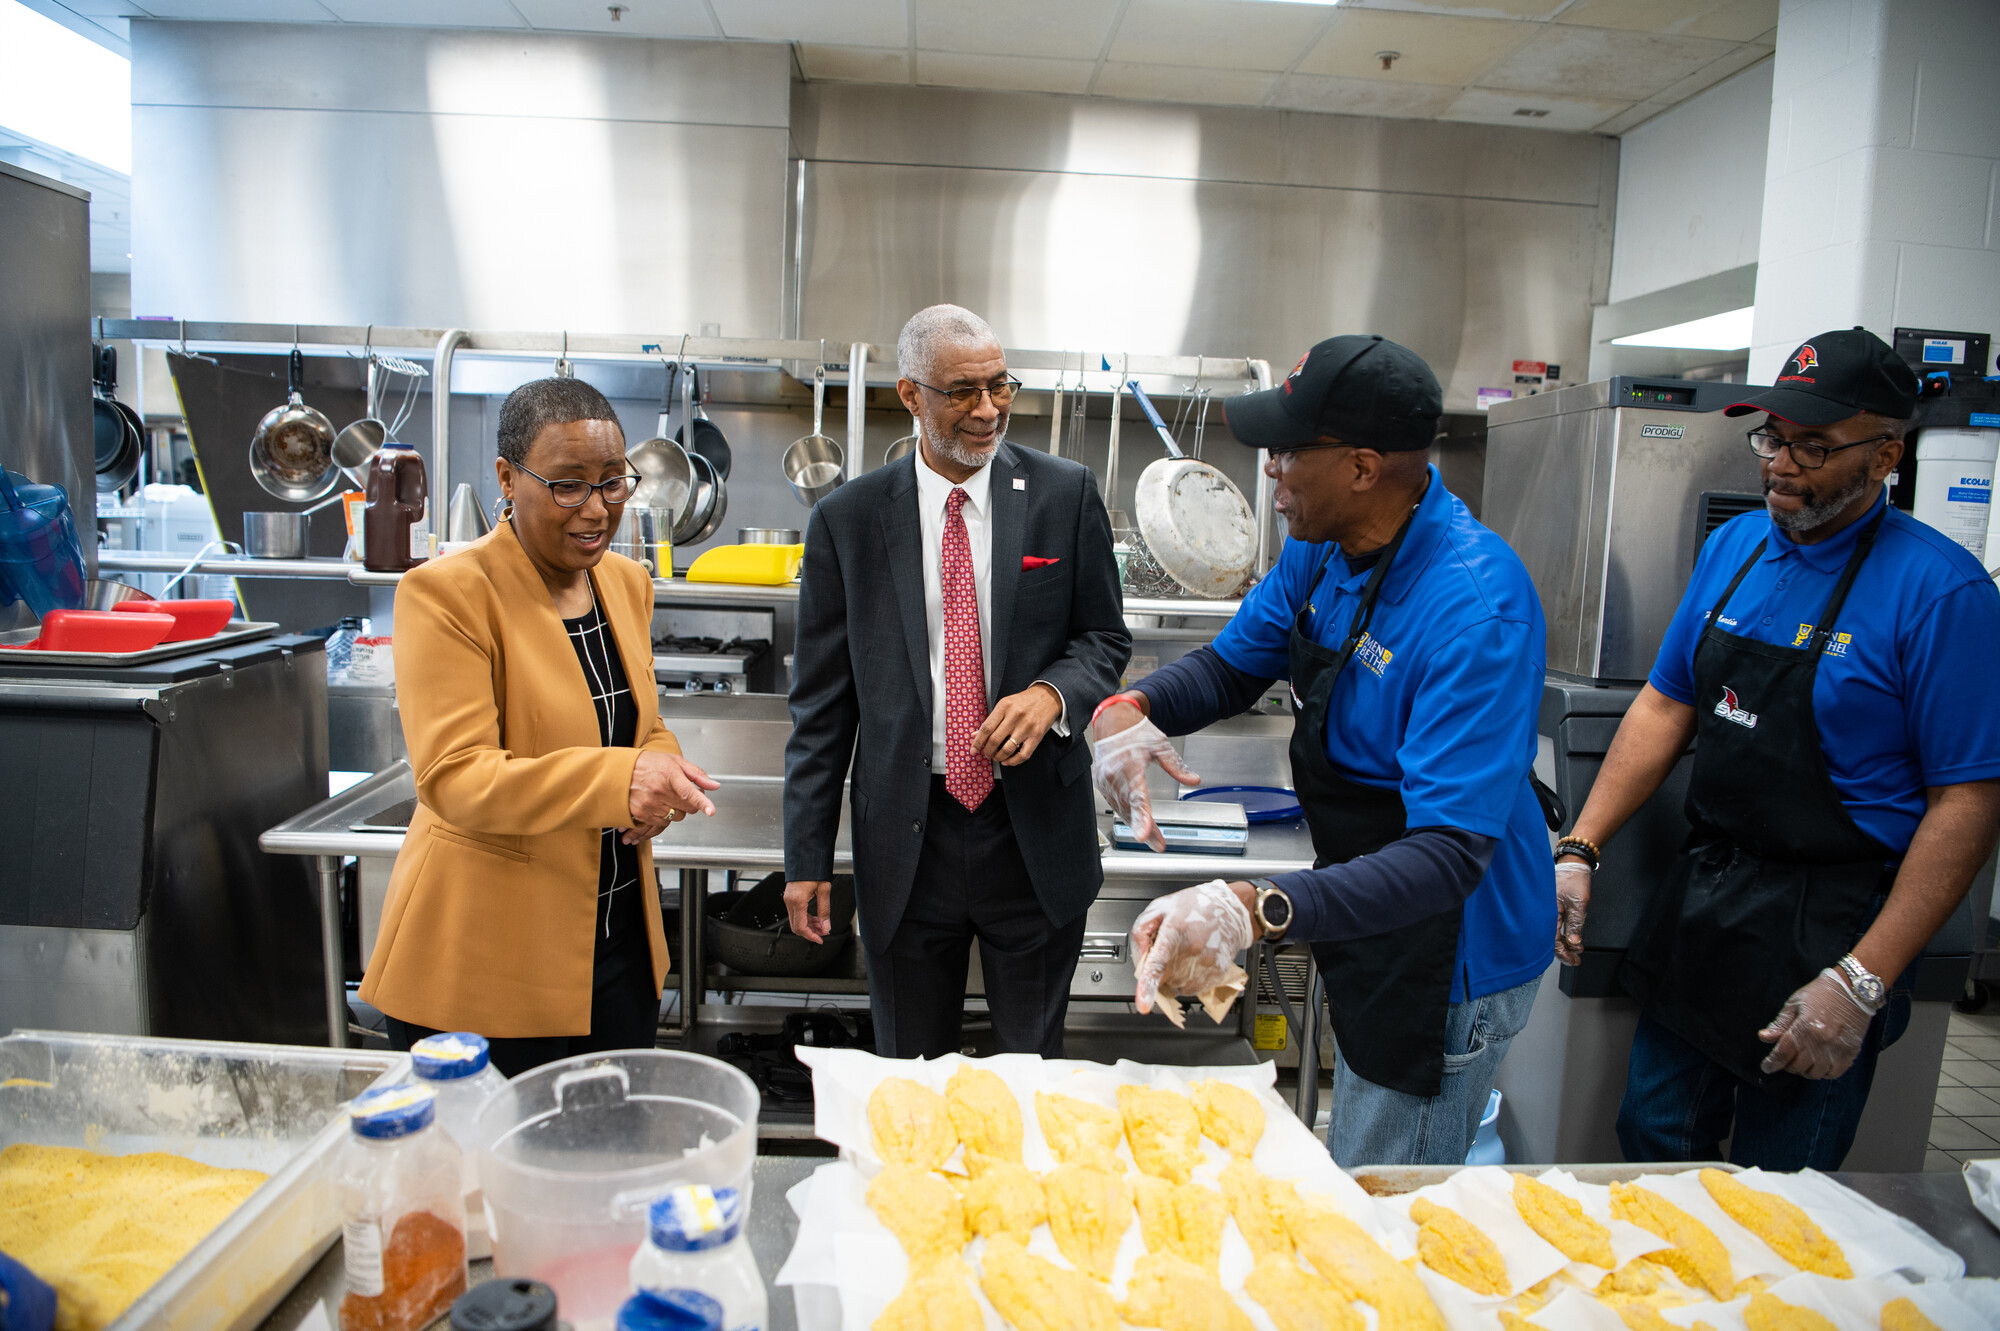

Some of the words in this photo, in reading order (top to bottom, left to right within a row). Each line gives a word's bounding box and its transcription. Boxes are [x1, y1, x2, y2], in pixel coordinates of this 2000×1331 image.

[1960, 477, 1990, 487] ECOLAB
[1364, 635, 1384, 657] MEN
[1359, 645, 1386, 674] BETHEL
[1713, 700, 1758, 729] SVSU
